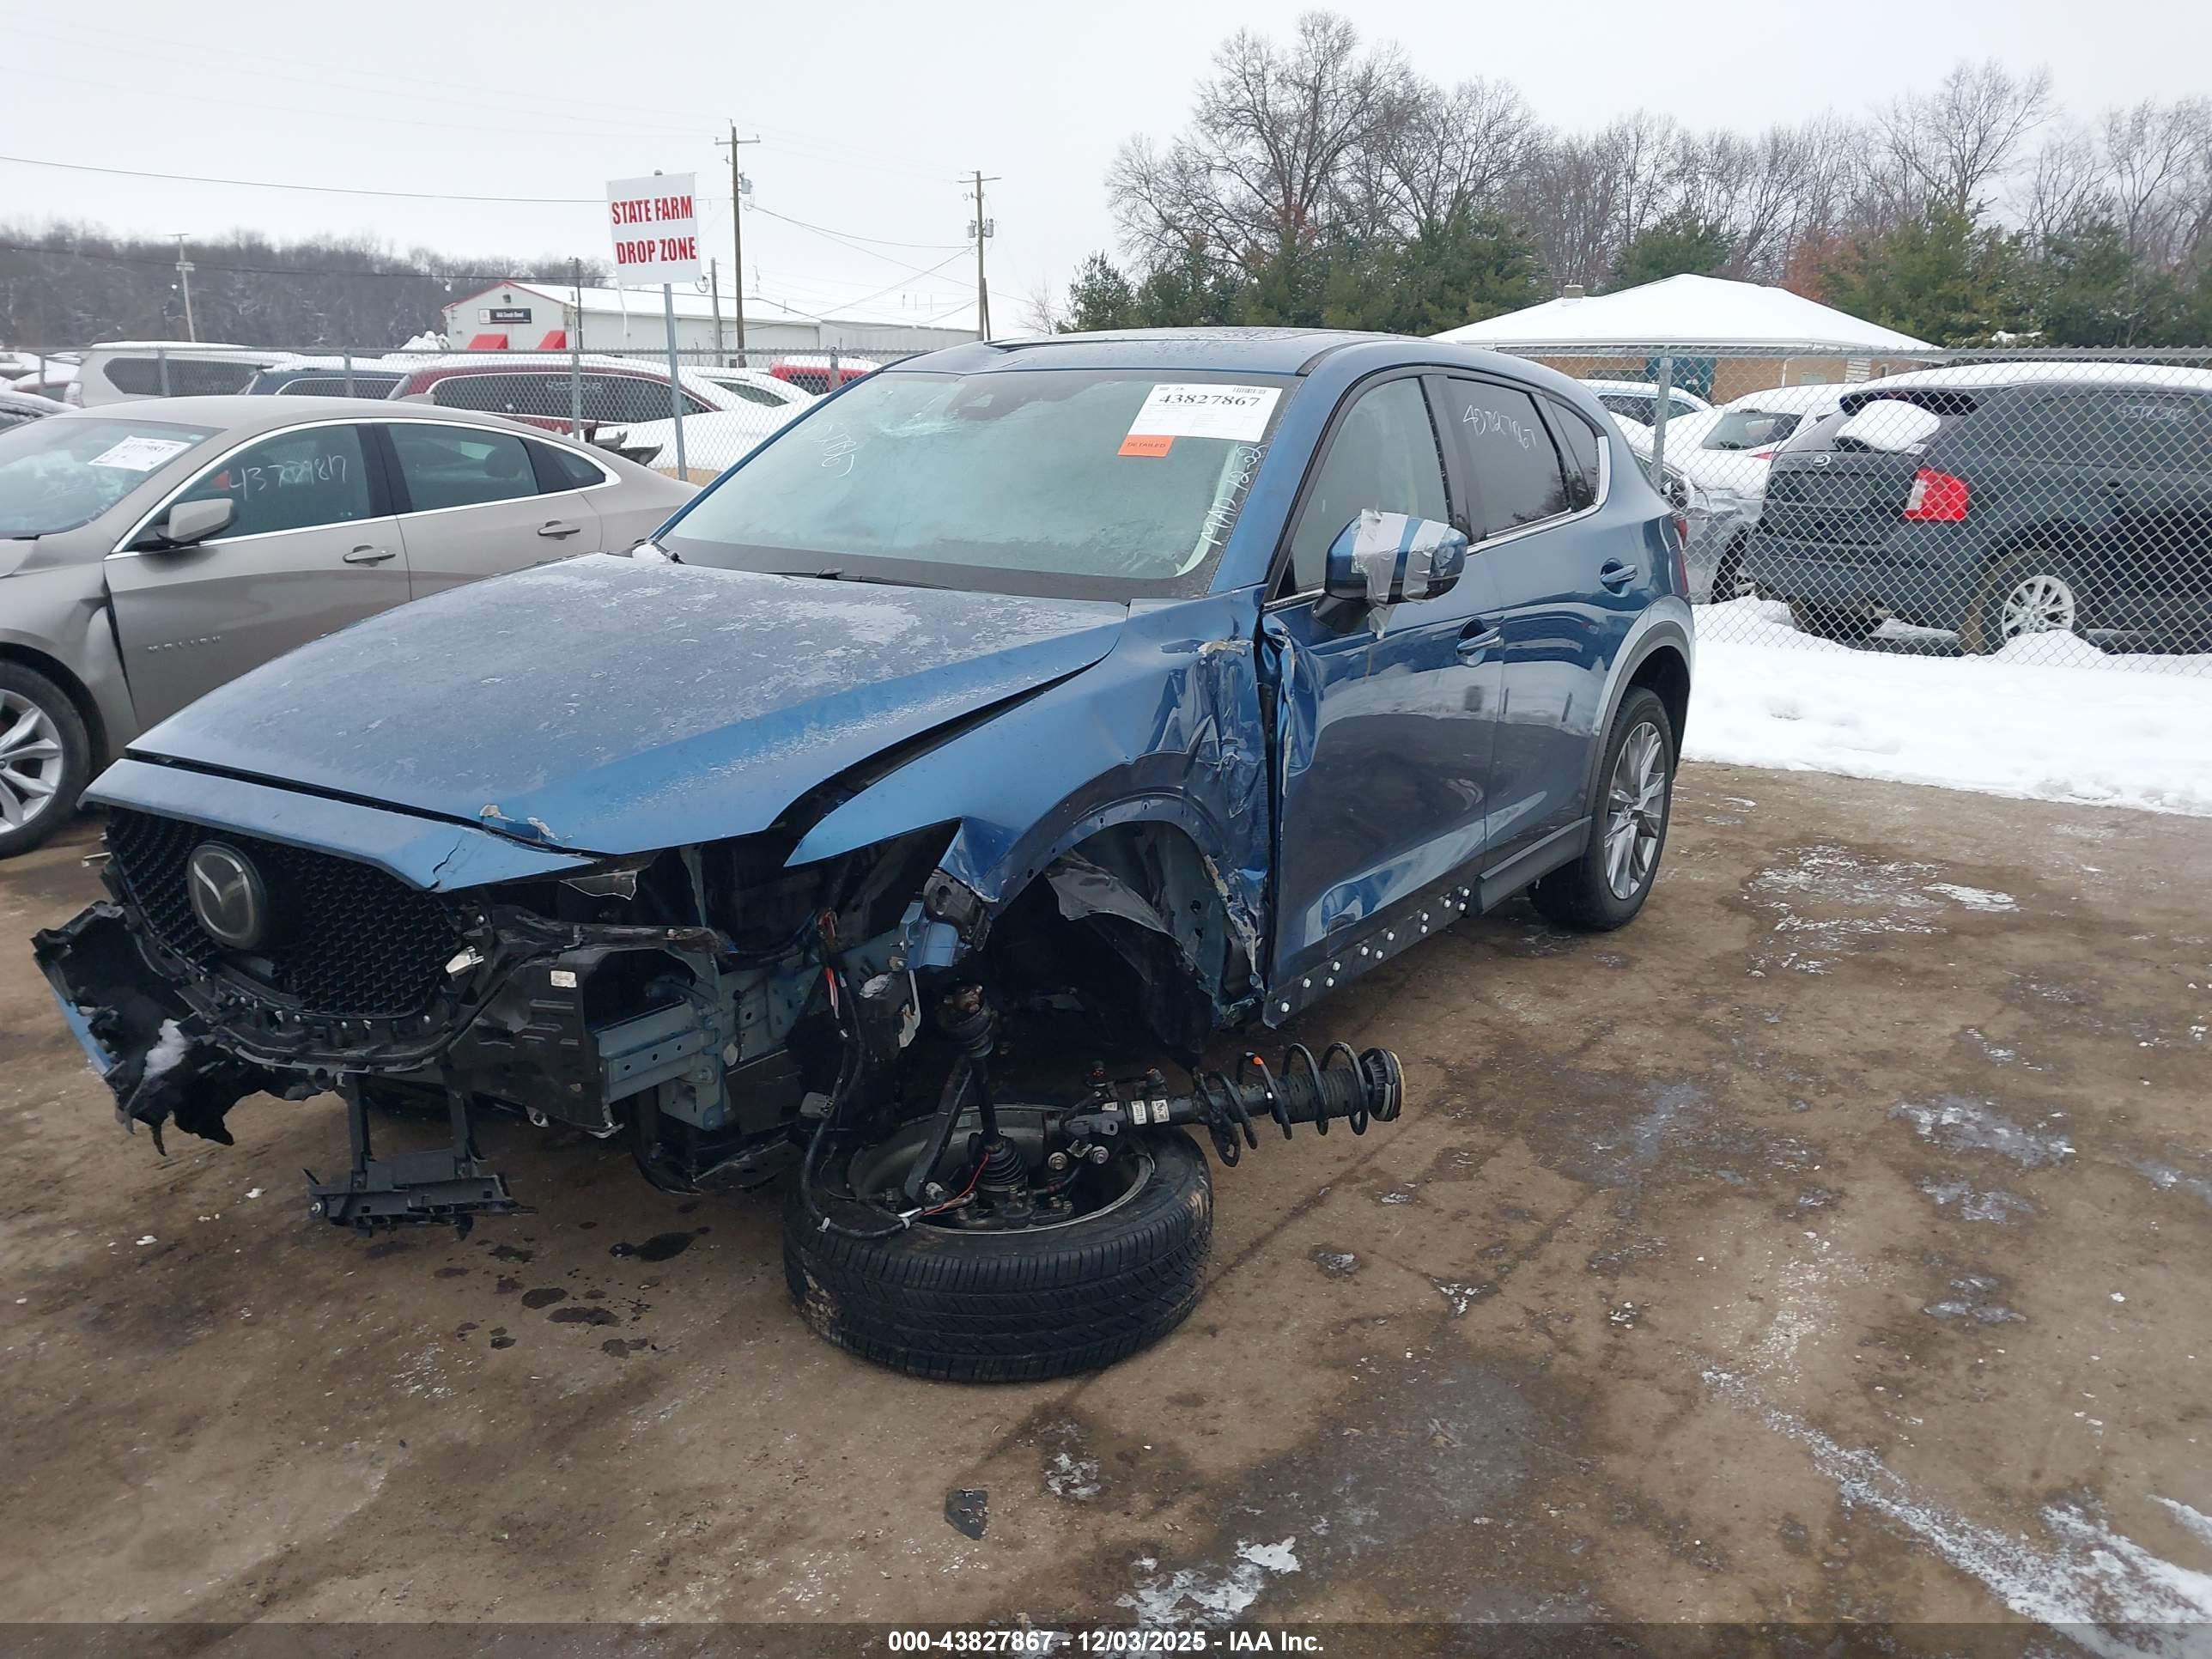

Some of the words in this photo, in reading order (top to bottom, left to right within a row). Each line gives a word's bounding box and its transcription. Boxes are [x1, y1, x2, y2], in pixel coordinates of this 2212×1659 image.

[611, 198, 652, 225] STATE
[653, 195, 693, 222] FARM
[616, 240, 656, 264] DROP
[659, 236, 697, 262] ZONE
[1158, 393, 1261, 407] 43827867
